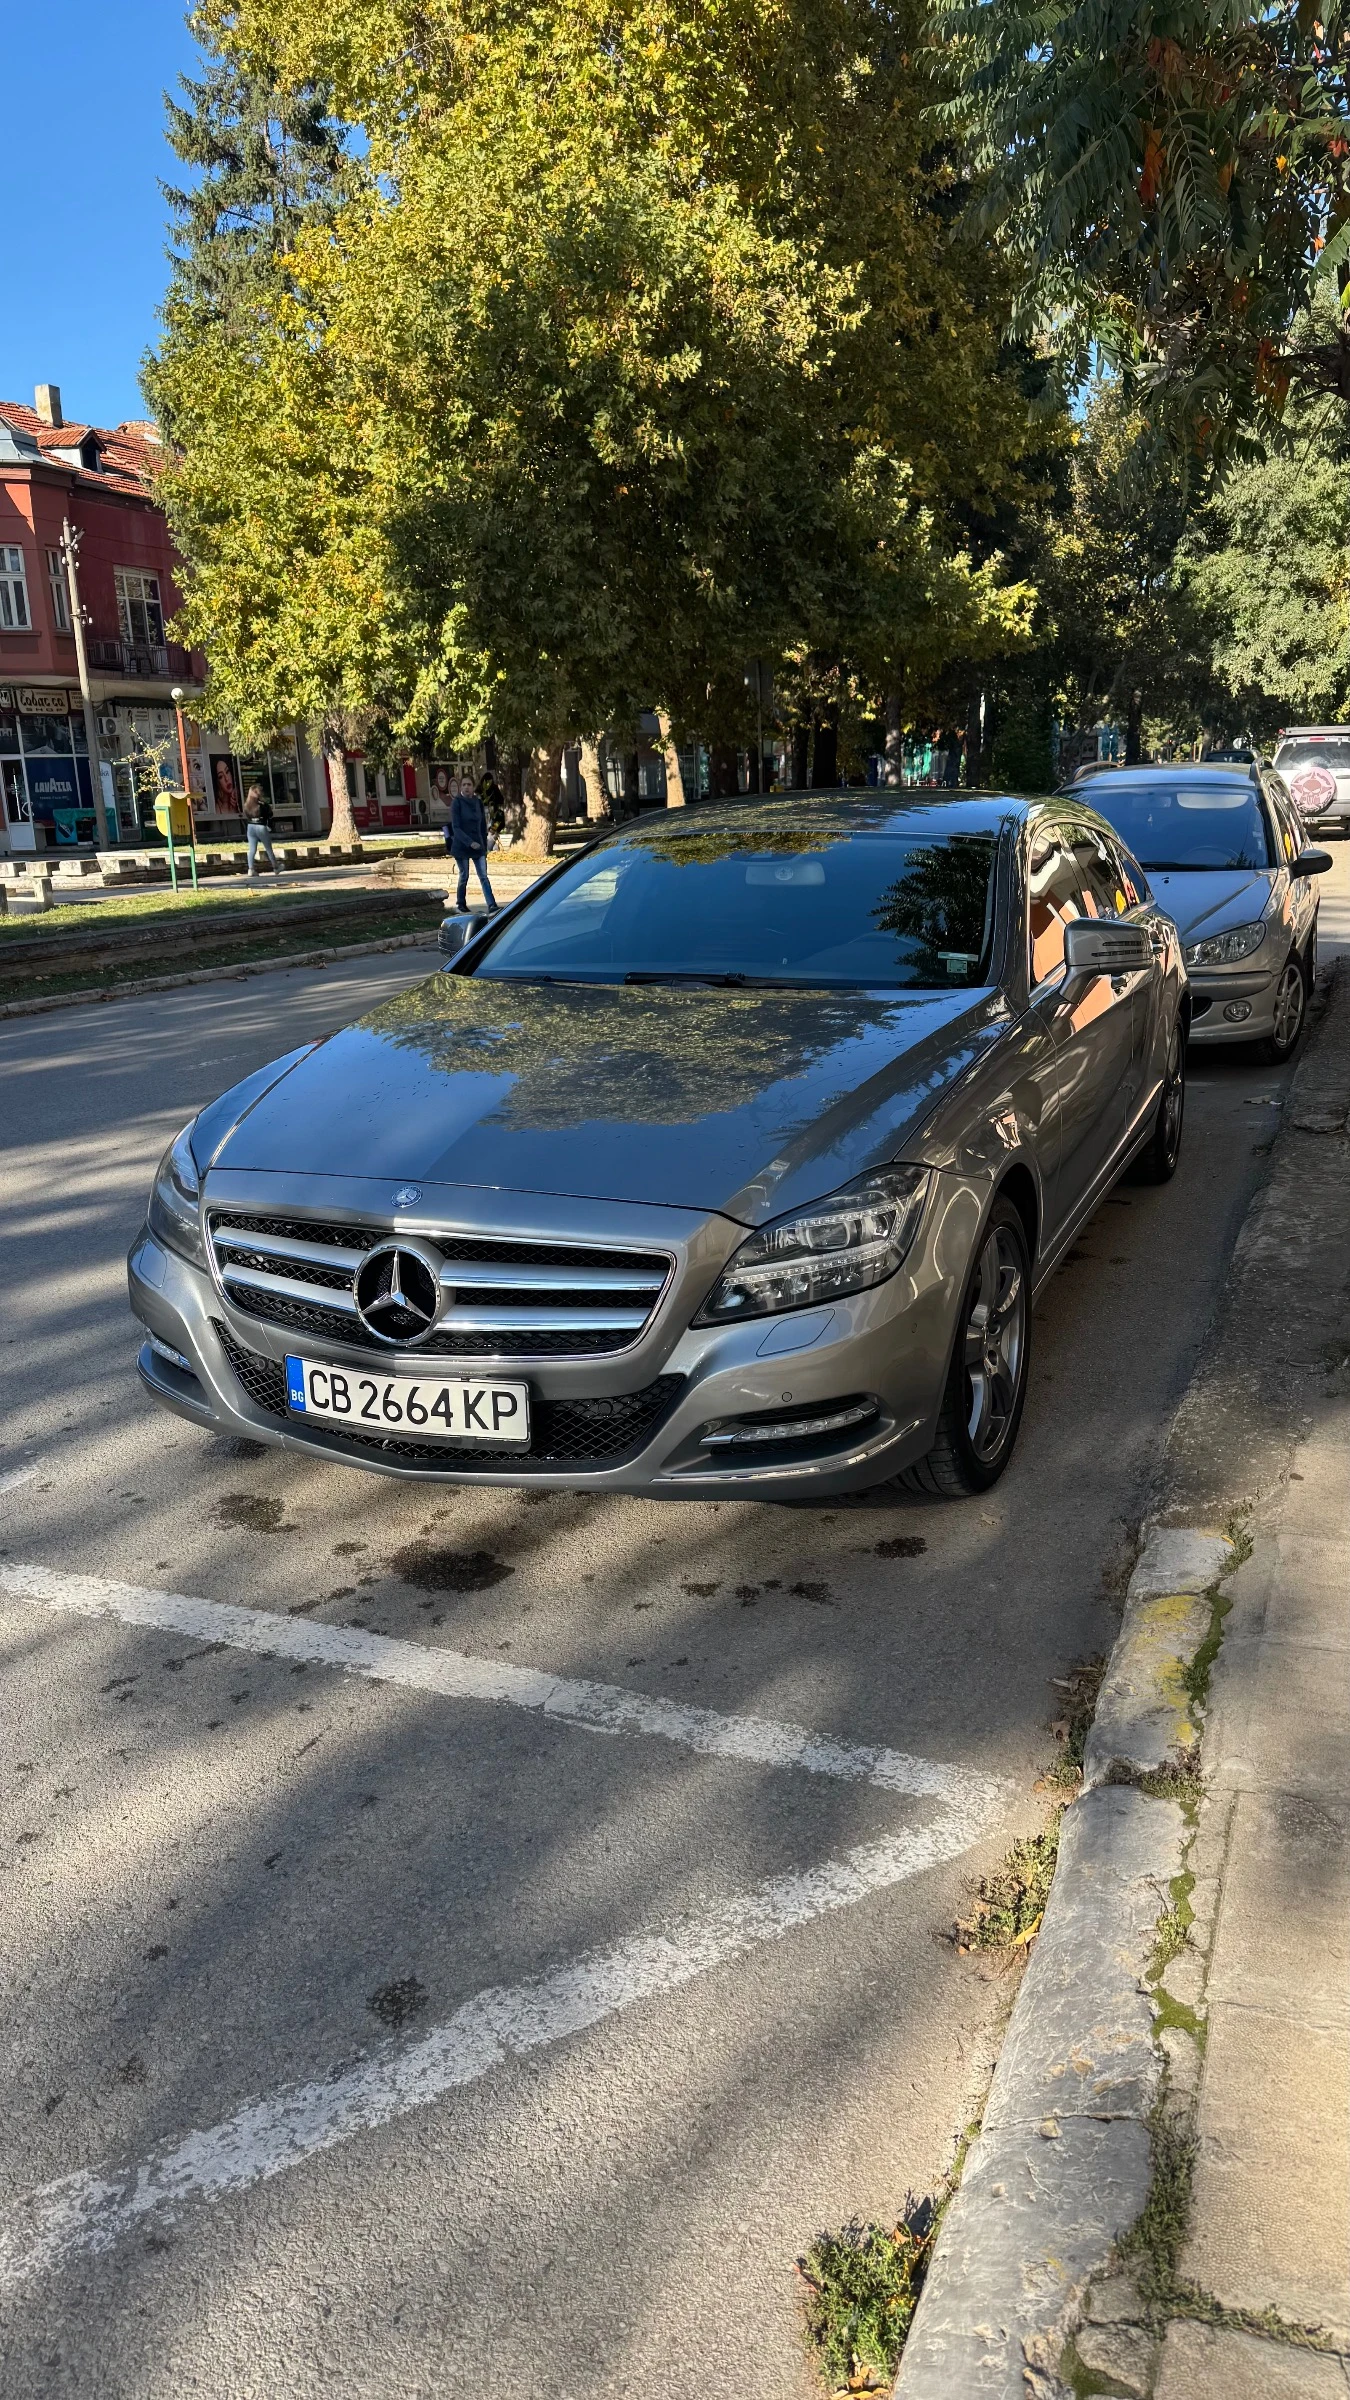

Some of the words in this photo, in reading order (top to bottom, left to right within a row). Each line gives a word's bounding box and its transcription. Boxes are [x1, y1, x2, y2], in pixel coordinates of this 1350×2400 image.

[34, 777, 73, 793] LAVAZZA
[291, 1389, 304, 1403] BG
[308, 1369, 352, 1414] CB
[358, 1380, 453, 1428] 2664
[463, 1389, 518, 1431] KP
